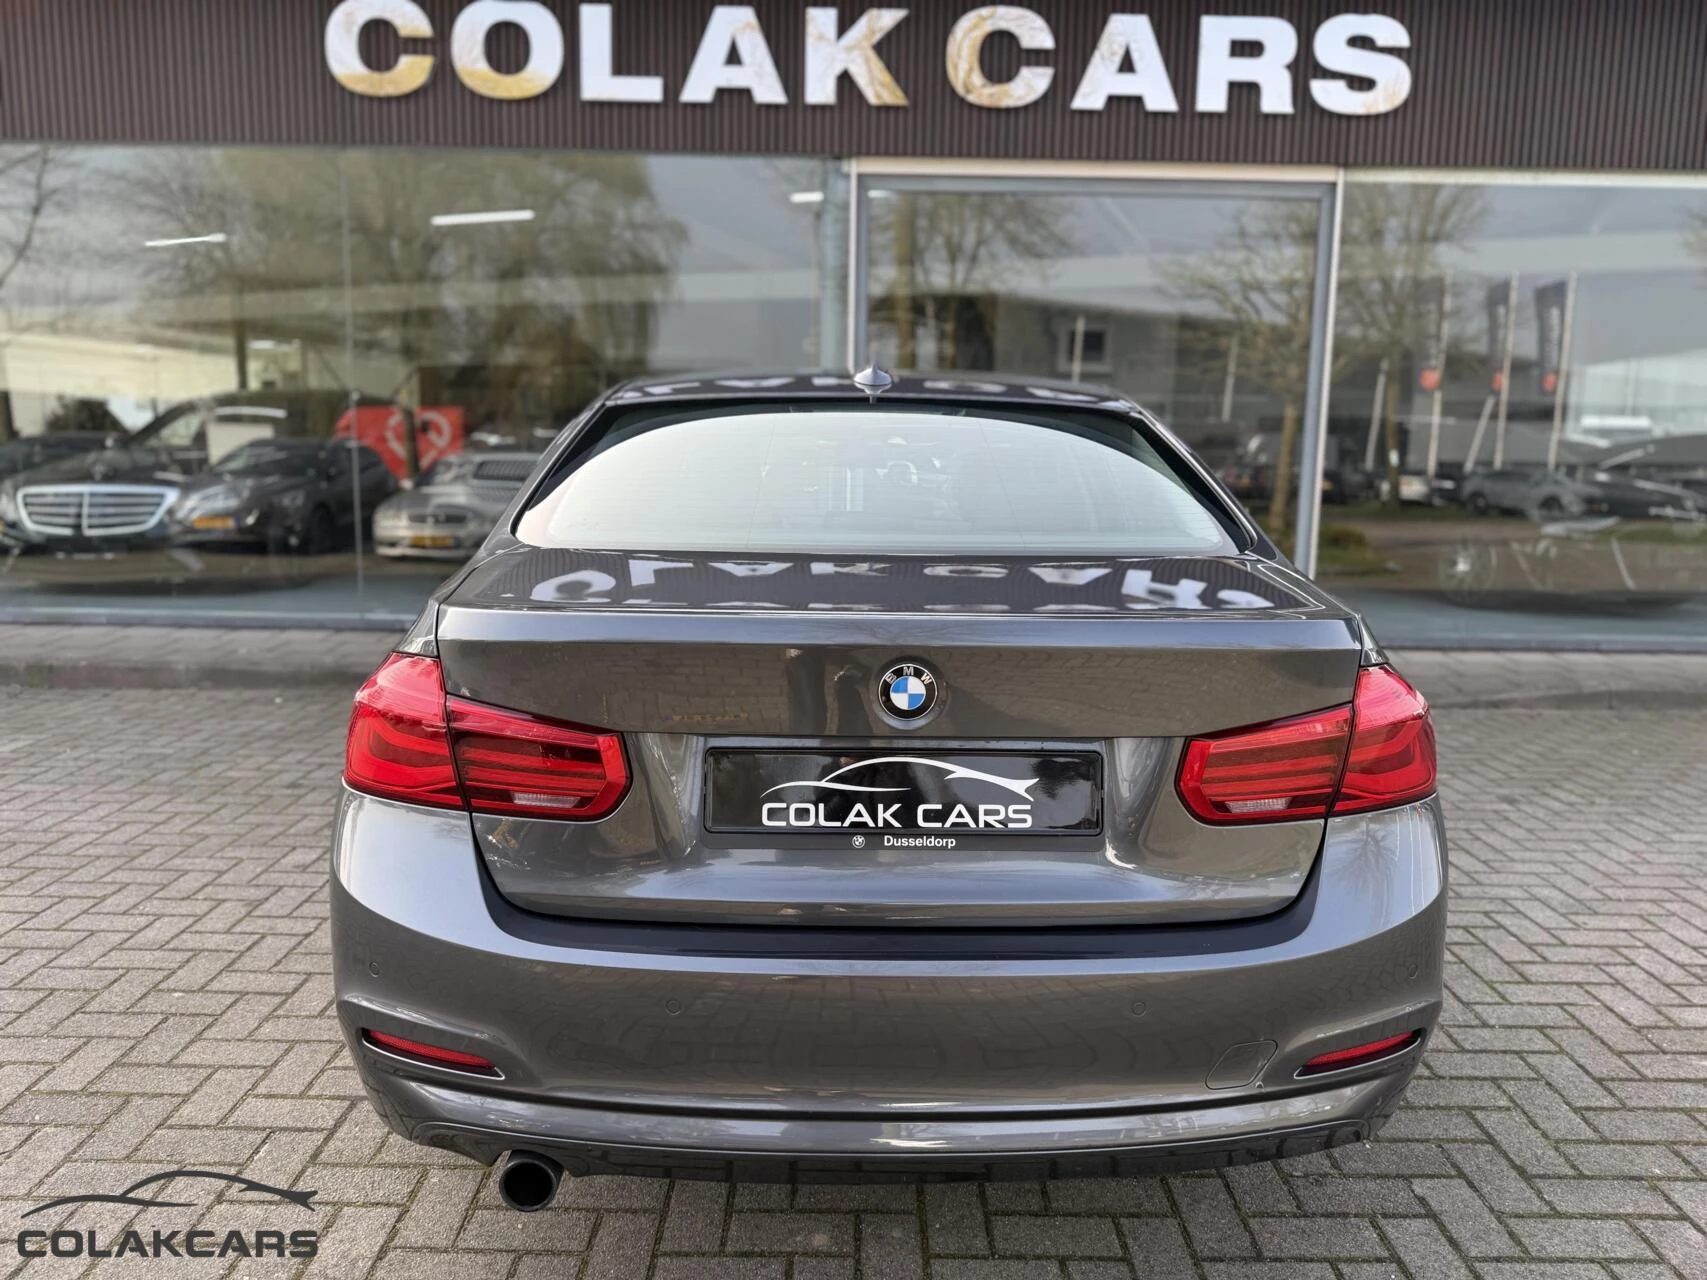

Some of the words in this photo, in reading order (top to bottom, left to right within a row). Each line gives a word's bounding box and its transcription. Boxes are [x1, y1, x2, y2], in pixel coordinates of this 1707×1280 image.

[324, 0, 908, 107] COLAK
[945, 5, 1412, 116] CARS
[884, 666, 932, 685] BMW
[761, 802, 902, 828] COLAK
[916, 803, 1033, 828] CARS
[884, 835, 956, 849] Dusseldorp
